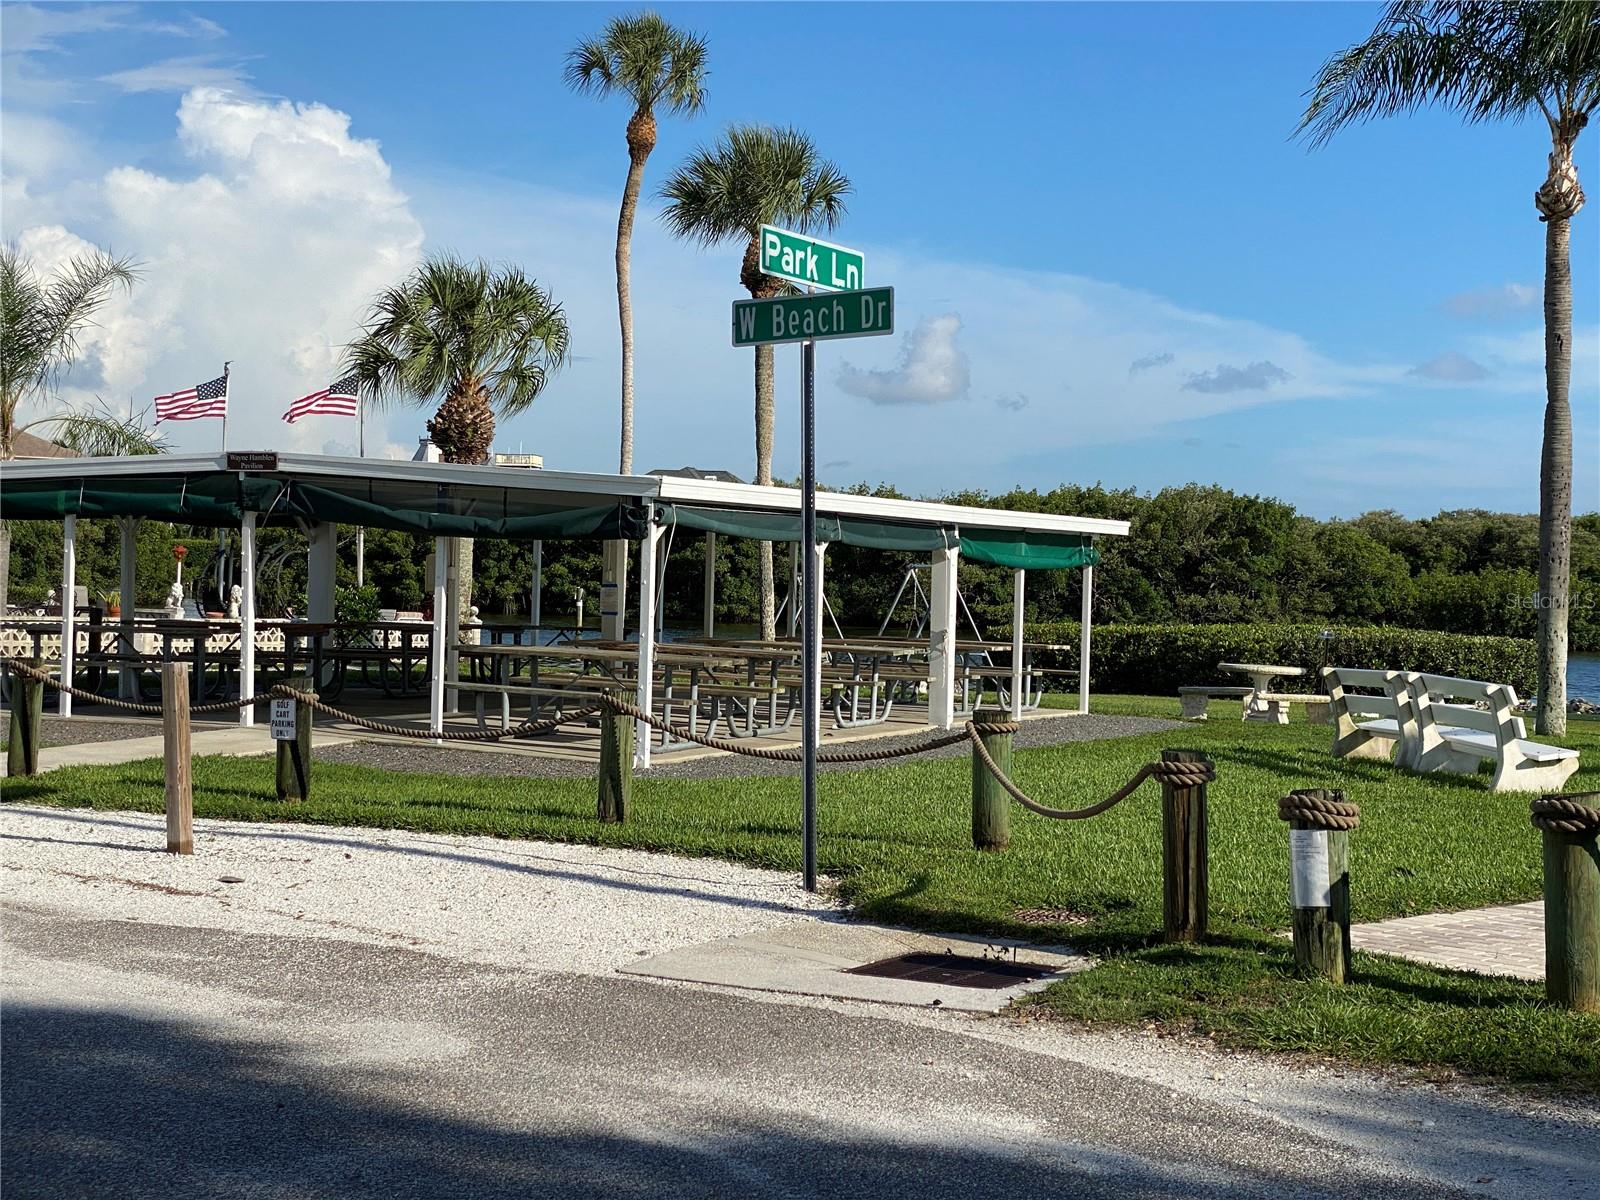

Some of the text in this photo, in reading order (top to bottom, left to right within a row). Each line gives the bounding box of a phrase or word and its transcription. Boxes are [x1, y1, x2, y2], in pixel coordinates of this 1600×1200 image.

[765, 232, 859, 290] Park Ln
[739, 295, 887, 340] W Beach Dr
[230, 454, 249, 463] Wayne
[275, 710, 290, 718] CART
[271, 719, 295, 728] PARKING
